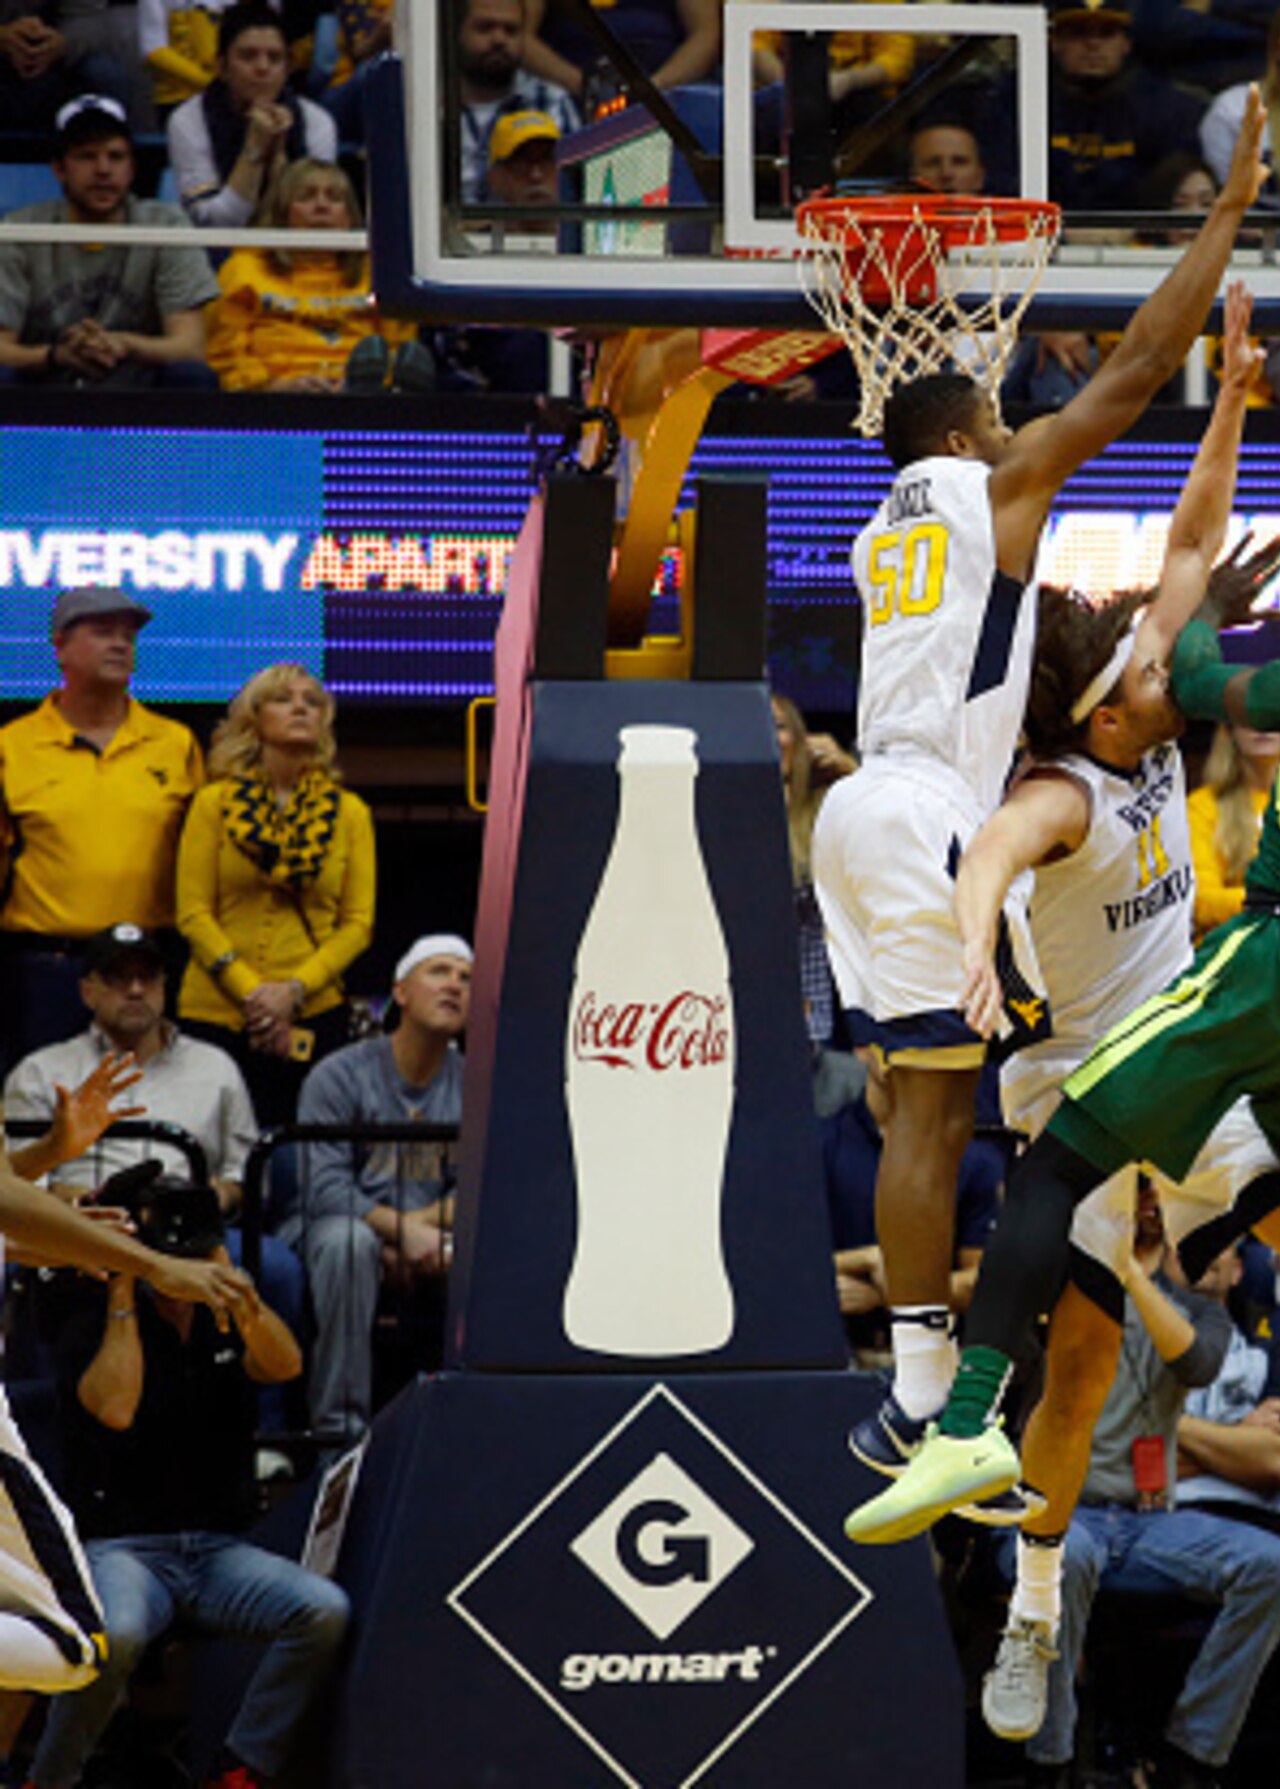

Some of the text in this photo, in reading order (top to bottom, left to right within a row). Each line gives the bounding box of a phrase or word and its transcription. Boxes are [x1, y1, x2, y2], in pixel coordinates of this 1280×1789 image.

[868, 521, 950, 628] 50
[616, 1499, 711, 1587] G
[560, 1646, 765, 1691] gomart
